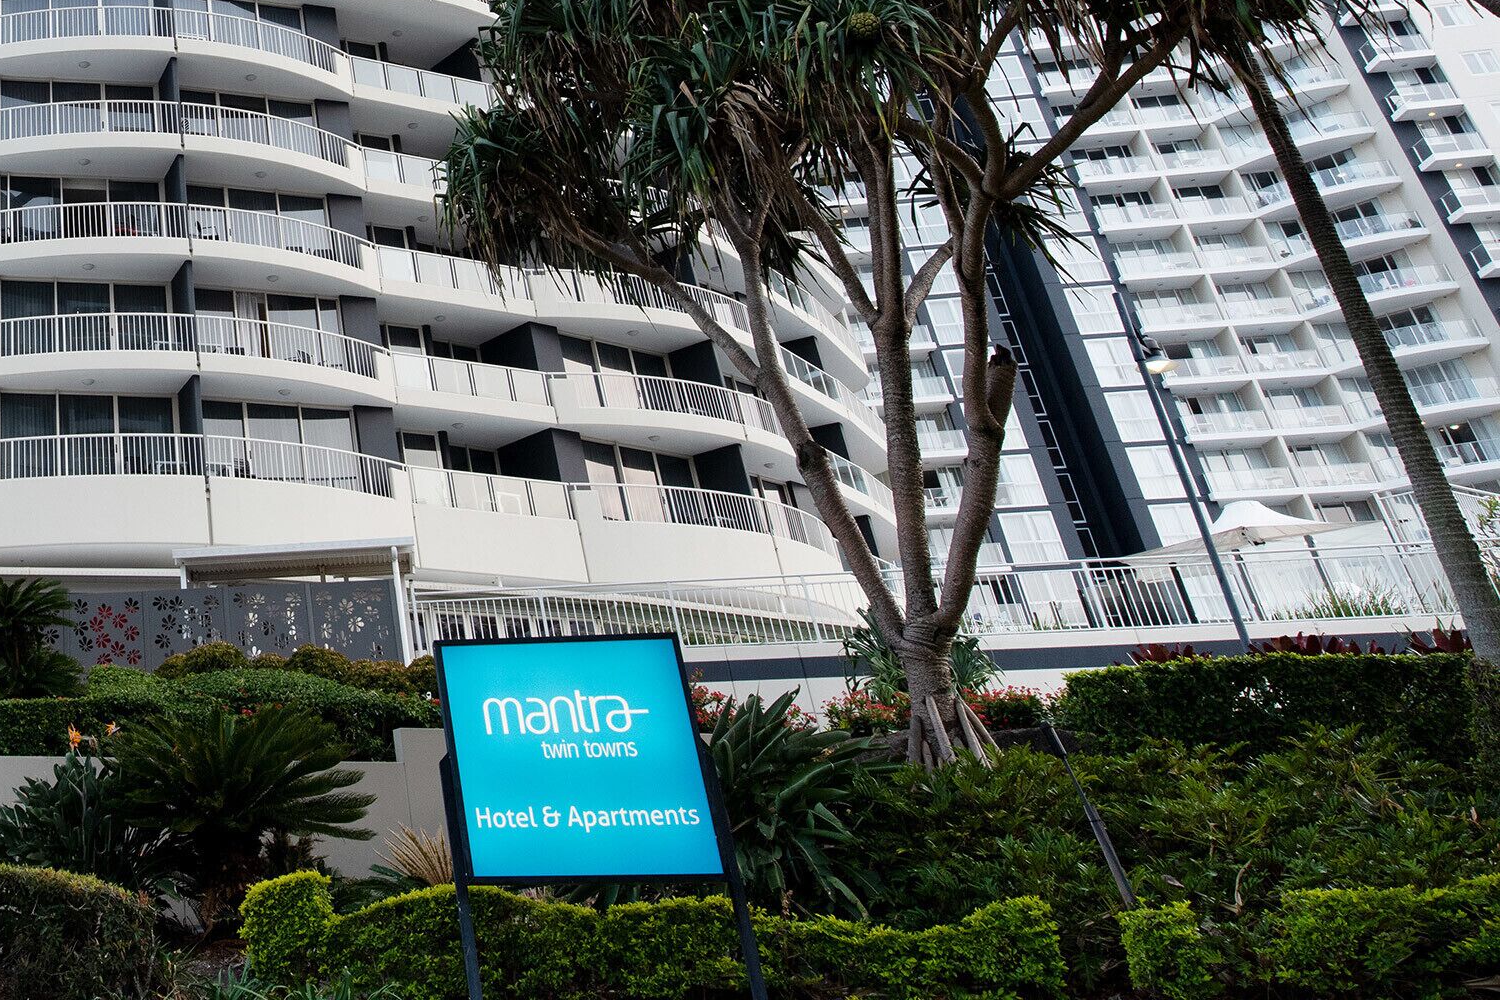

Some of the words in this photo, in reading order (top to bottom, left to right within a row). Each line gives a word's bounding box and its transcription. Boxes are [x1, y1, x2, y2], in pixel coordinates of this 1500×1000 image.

[482, 689, 649, 735] mantra
[541, 739, 580, 759] twin
[583, 738, 638, 759] towns
[475, 805, 538, 829] Hotel
[543, 805, 561, 828] &
[567, 805, 700, 833] Apartments
